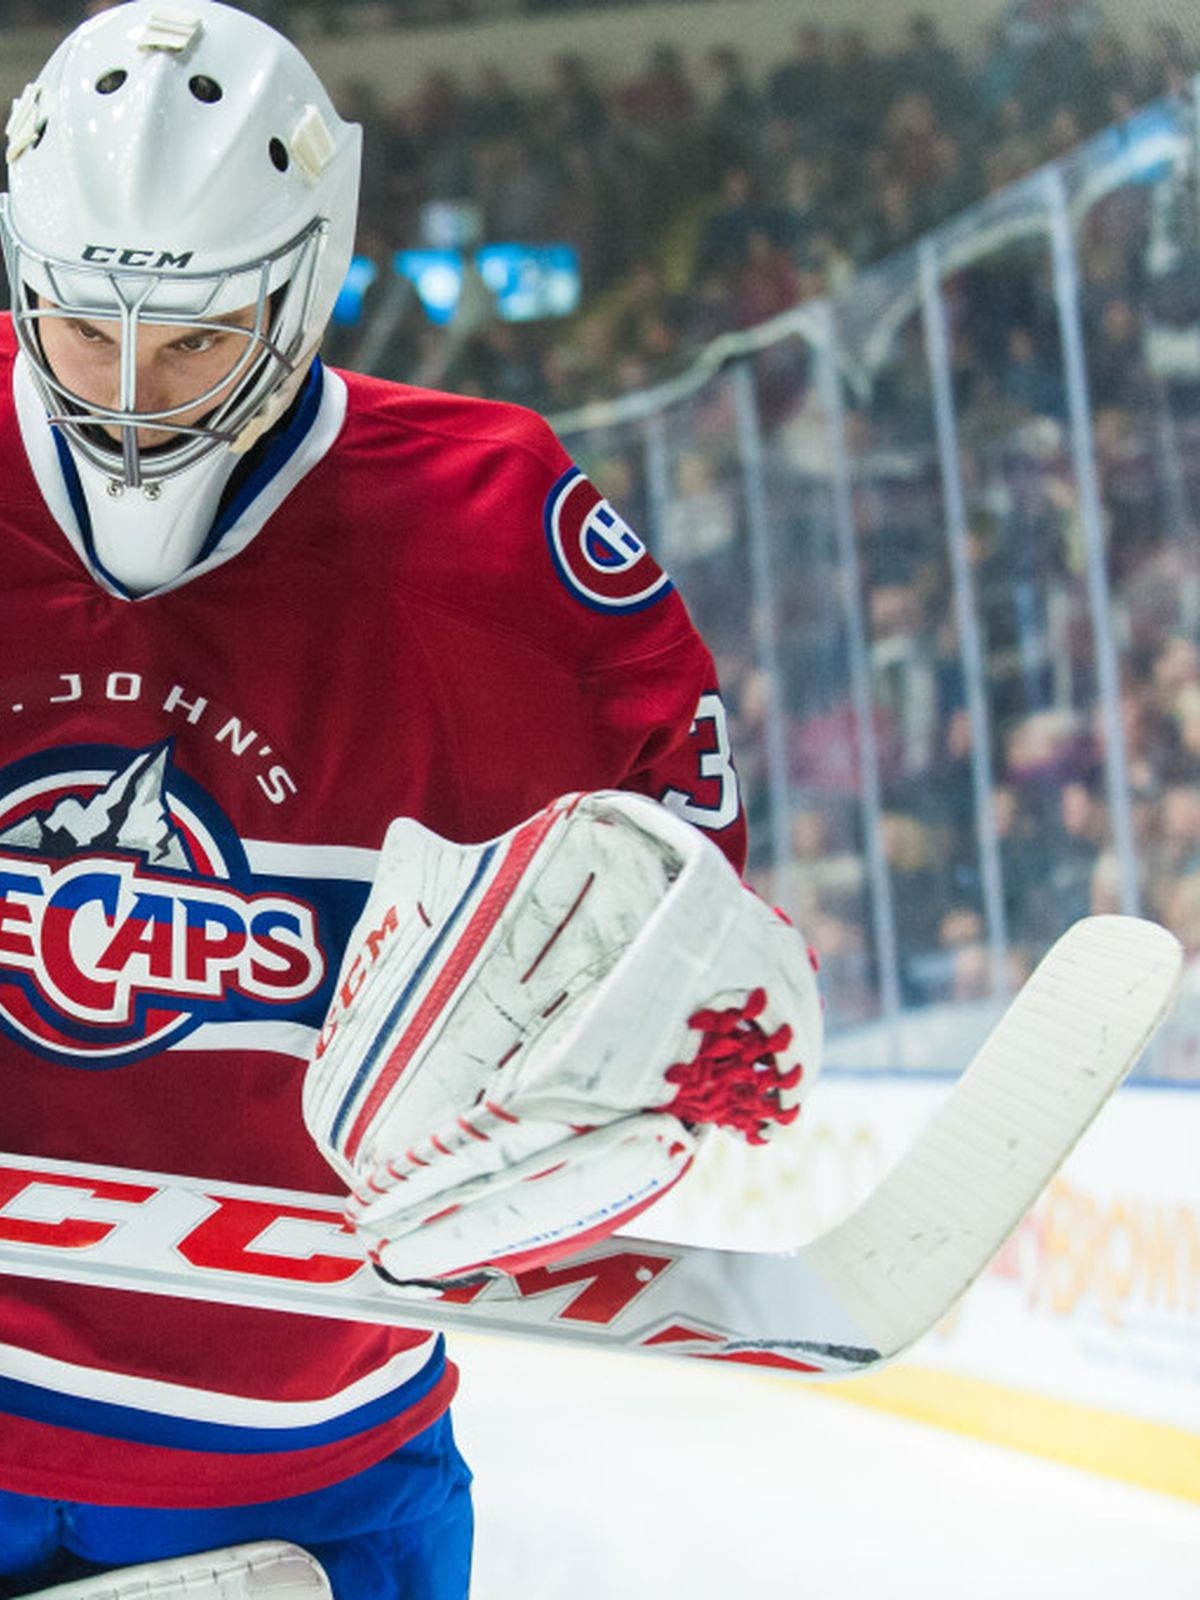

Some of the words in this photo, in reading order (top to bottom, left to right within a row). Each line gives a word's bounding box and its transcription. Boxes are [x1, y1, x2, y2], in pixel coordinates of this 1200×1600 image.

[81, 245, 194, 268] CCM
[50, 672, 298, 804] JOHN'S
[315, 905, 399, 1060] CCM
